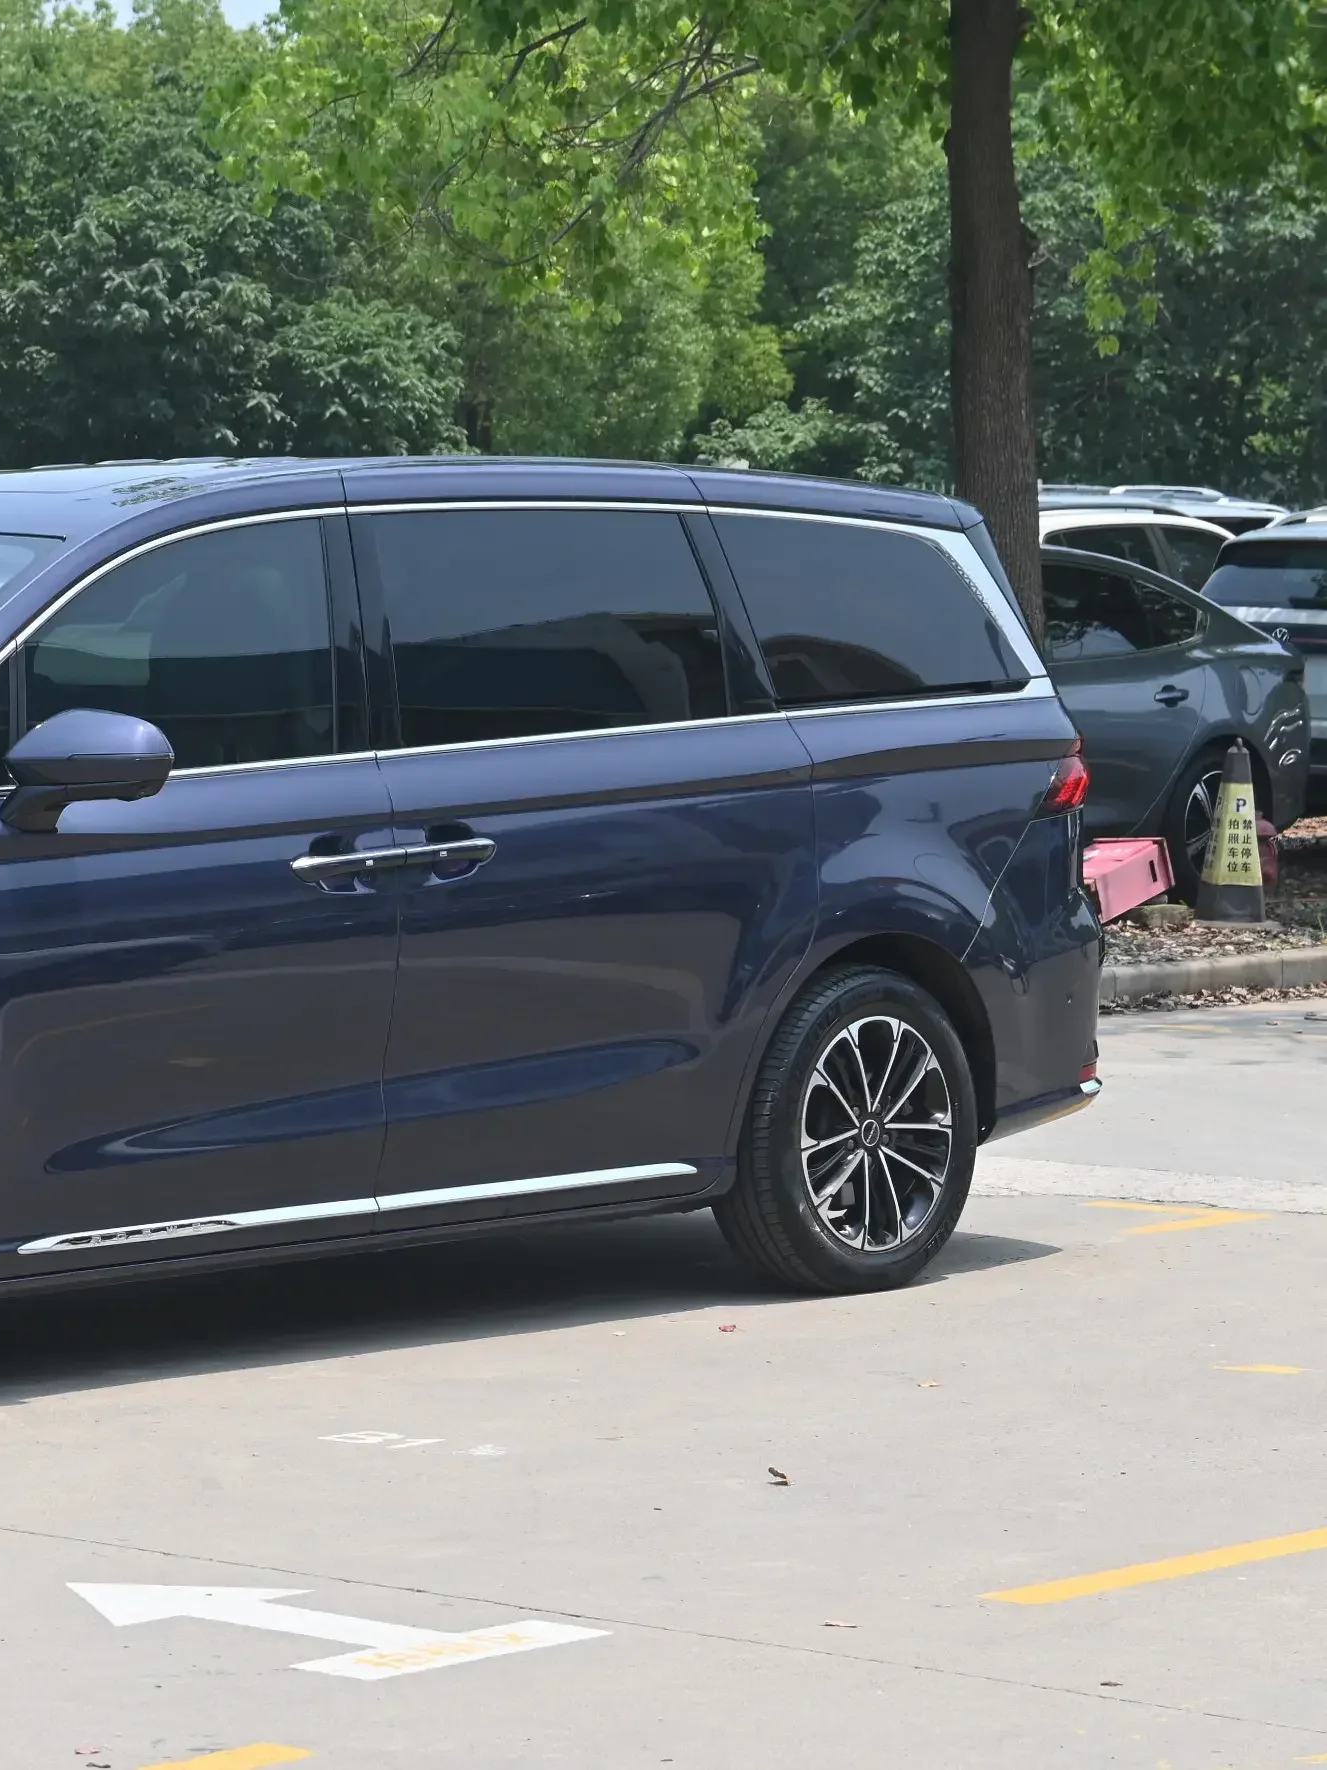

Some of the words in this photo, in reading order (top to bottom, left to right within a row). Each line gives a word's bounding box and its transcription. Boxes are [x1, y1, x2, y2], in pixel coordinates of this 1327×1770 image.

[1236, 797, 1247, 813] P
[1227, 818, 1240, 873] 拍照车位
[1240, 818, 1253, 873] 禁止停车
